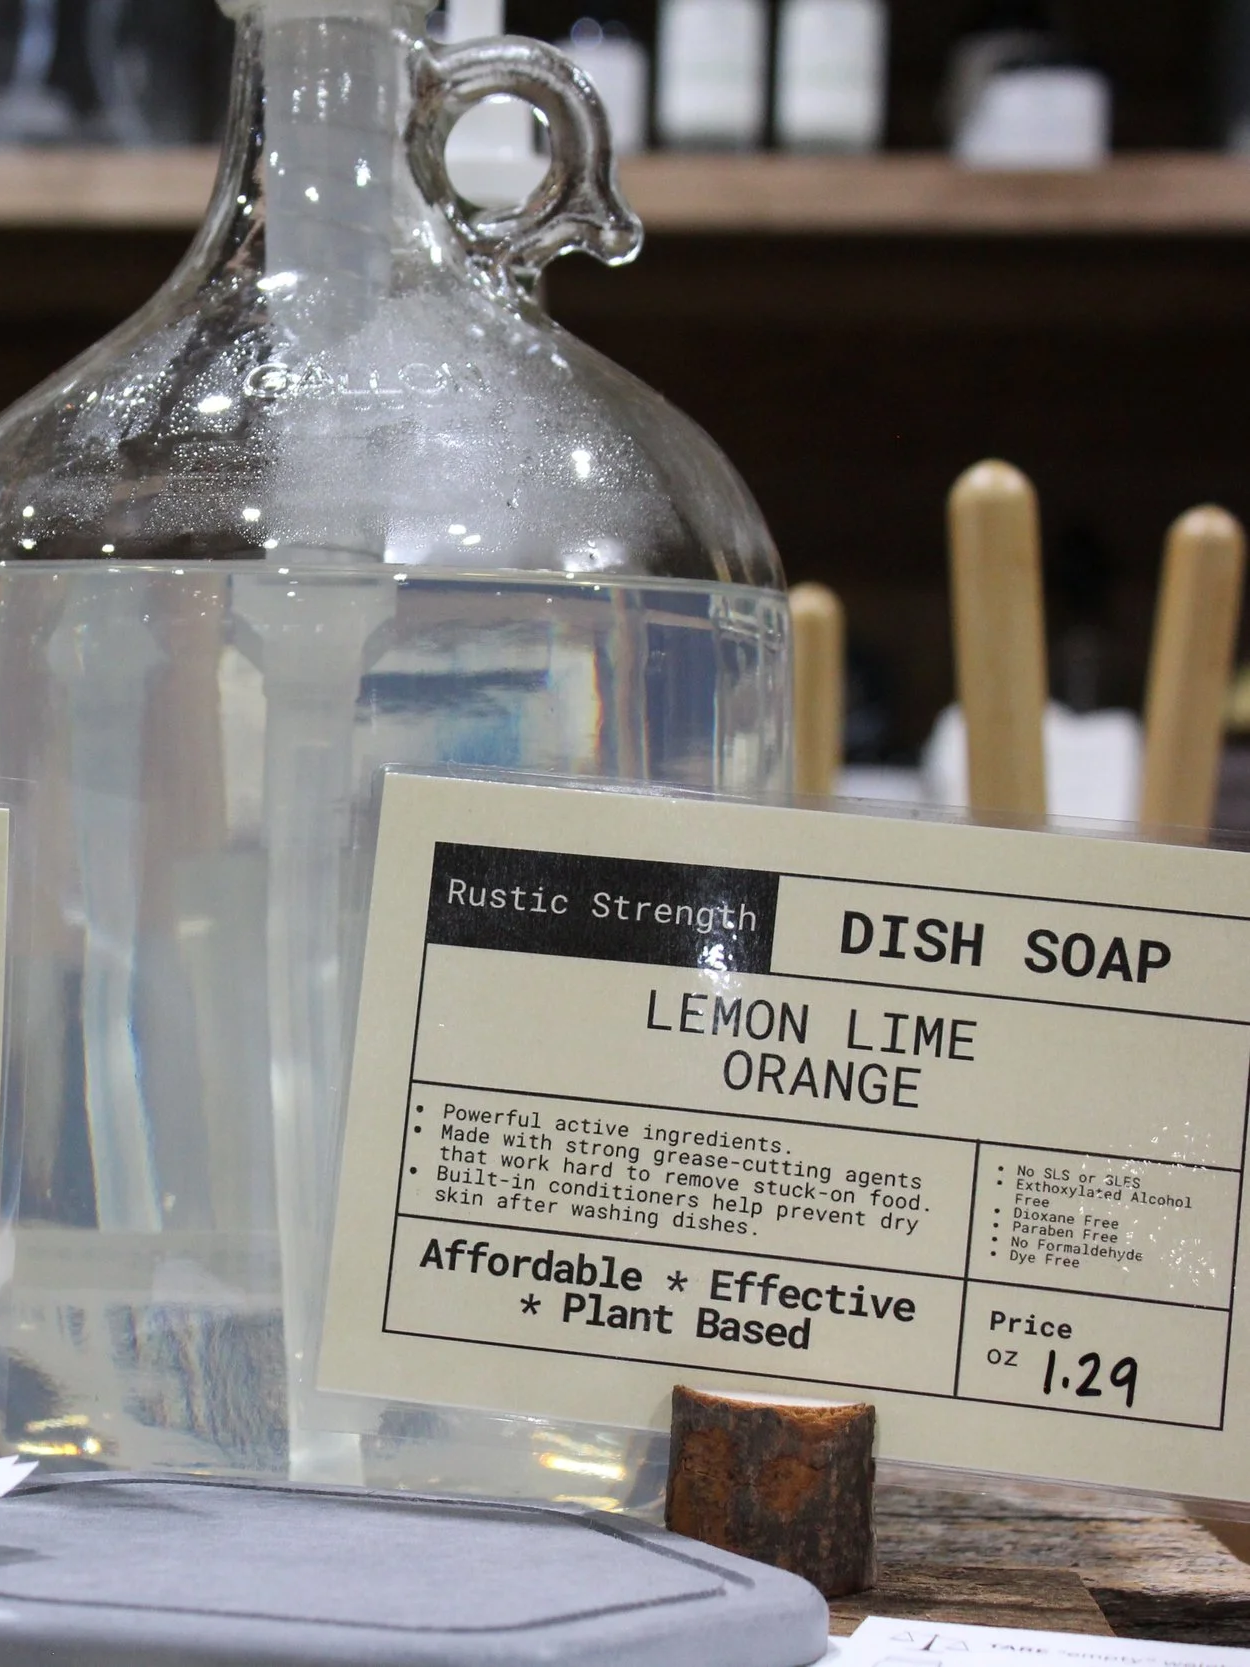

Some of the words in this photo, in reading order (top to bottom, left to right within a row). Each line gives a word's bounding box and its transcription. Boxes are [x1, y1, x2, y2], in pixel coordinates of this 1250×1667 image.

[447, 878, 568, 915] Rustic
[591, 892, 757, 937] Strength
[840, 910, 985, 967] DISH
[1024, 928, 1172, 984] SOAP
[646, 989, 809, 1044] LEMON
[847, 1008, 978, 1062] LIME
[723, 1049, 922, 1109] ORANGE
[443, 1103, 541, 1129] Powerful
[555, 1118, 629, 1138] active
[643, 1124, 791, 1155] ingredients.
[440, 1145, 487, 1165] that
[501, 1154, 549, 1172] work
[563, 1156, 613, 1178] hard
[626, 1165, 651, 1182] to
[665, 1171, 739, 1192] remove
[753, 1180, 855, 1204] stuck-on
[870, 1189, 930, 1212] food.
[441, 1124, 490, 1145] Made
[503, 1132, 552, 1151] with
[566, 1139, 640, 1164] strong
[653, 1149, 831, 1184] grease-cutting
[845, 1169, 922, 1191] agents
[1017, 1165, 1035, 1178] No
[1043, 1167, 1070, 1181] SLS
[1078, 1173, 1096, 1184] or
[434, 1186, 483, 1206] skin
[497, 1193, 558, 1214] after
[571, 1203, 659, 1229] washing
[672, 1211, 757, 1236] dishes.
[436, 1165, 535, 1191] Built-in
[548, 1180, 699, 1208] conditioners
[713, 1193, 763, 1218] help
[776, 1204, 866, 1226] prevent
[880, 1212, 919, 1236] dry
[1013, 1206, 1075, 1225] Dioxane
[1084, 1214, 1119, 1230] Free
[1015, 1193, 1050, 1208] Free
[1130, 1191, 1192, 1209] Alcohol
[1009, 1249, 1036, 1265] Dye
[1045, 1253, 1080, 1268] Free
[1011, 1236, 1029, 1249] No
[1037, 1238, 1143, 1262] Formaldehyde
[1012, 1220, 1074, 1239] Paraben
[1082, 1228, 1118, 1244] Free
[419, 1238, 643, 1292] Affordable
[710, 1269, 916, 1323] Effective
[562, 1292, 673, 1335] Plant
[695, 1307, 812, 1350] Based
[989, 1310, 1073, 1340] Price
[987, 1348, 1018, 1367] oz
[1043, 1349, 1138, 1409] 1.29
